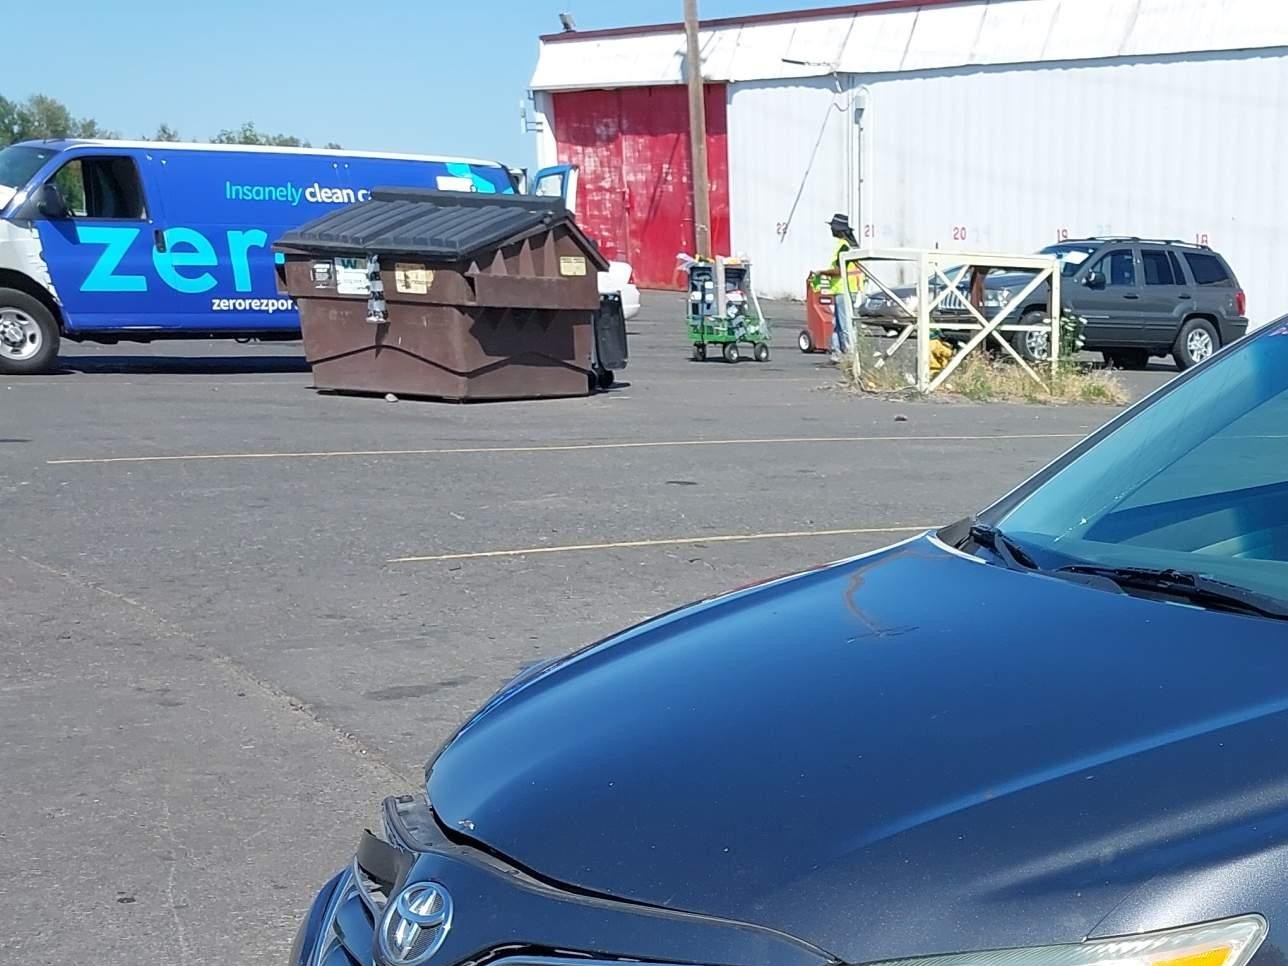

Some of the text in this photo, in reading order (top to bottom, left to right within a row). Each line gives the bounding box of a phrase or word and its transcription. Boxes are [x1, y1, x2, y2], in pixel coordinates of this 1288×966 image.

[226, 181, 302, 206] Insanely
[305, 183, 355, 203] clean
[776, 222, 787, 235] 22
[864, 224, 875, 238] 21
[953, 227, 967, 241] 20
[75, 225, 285, 294] zer
